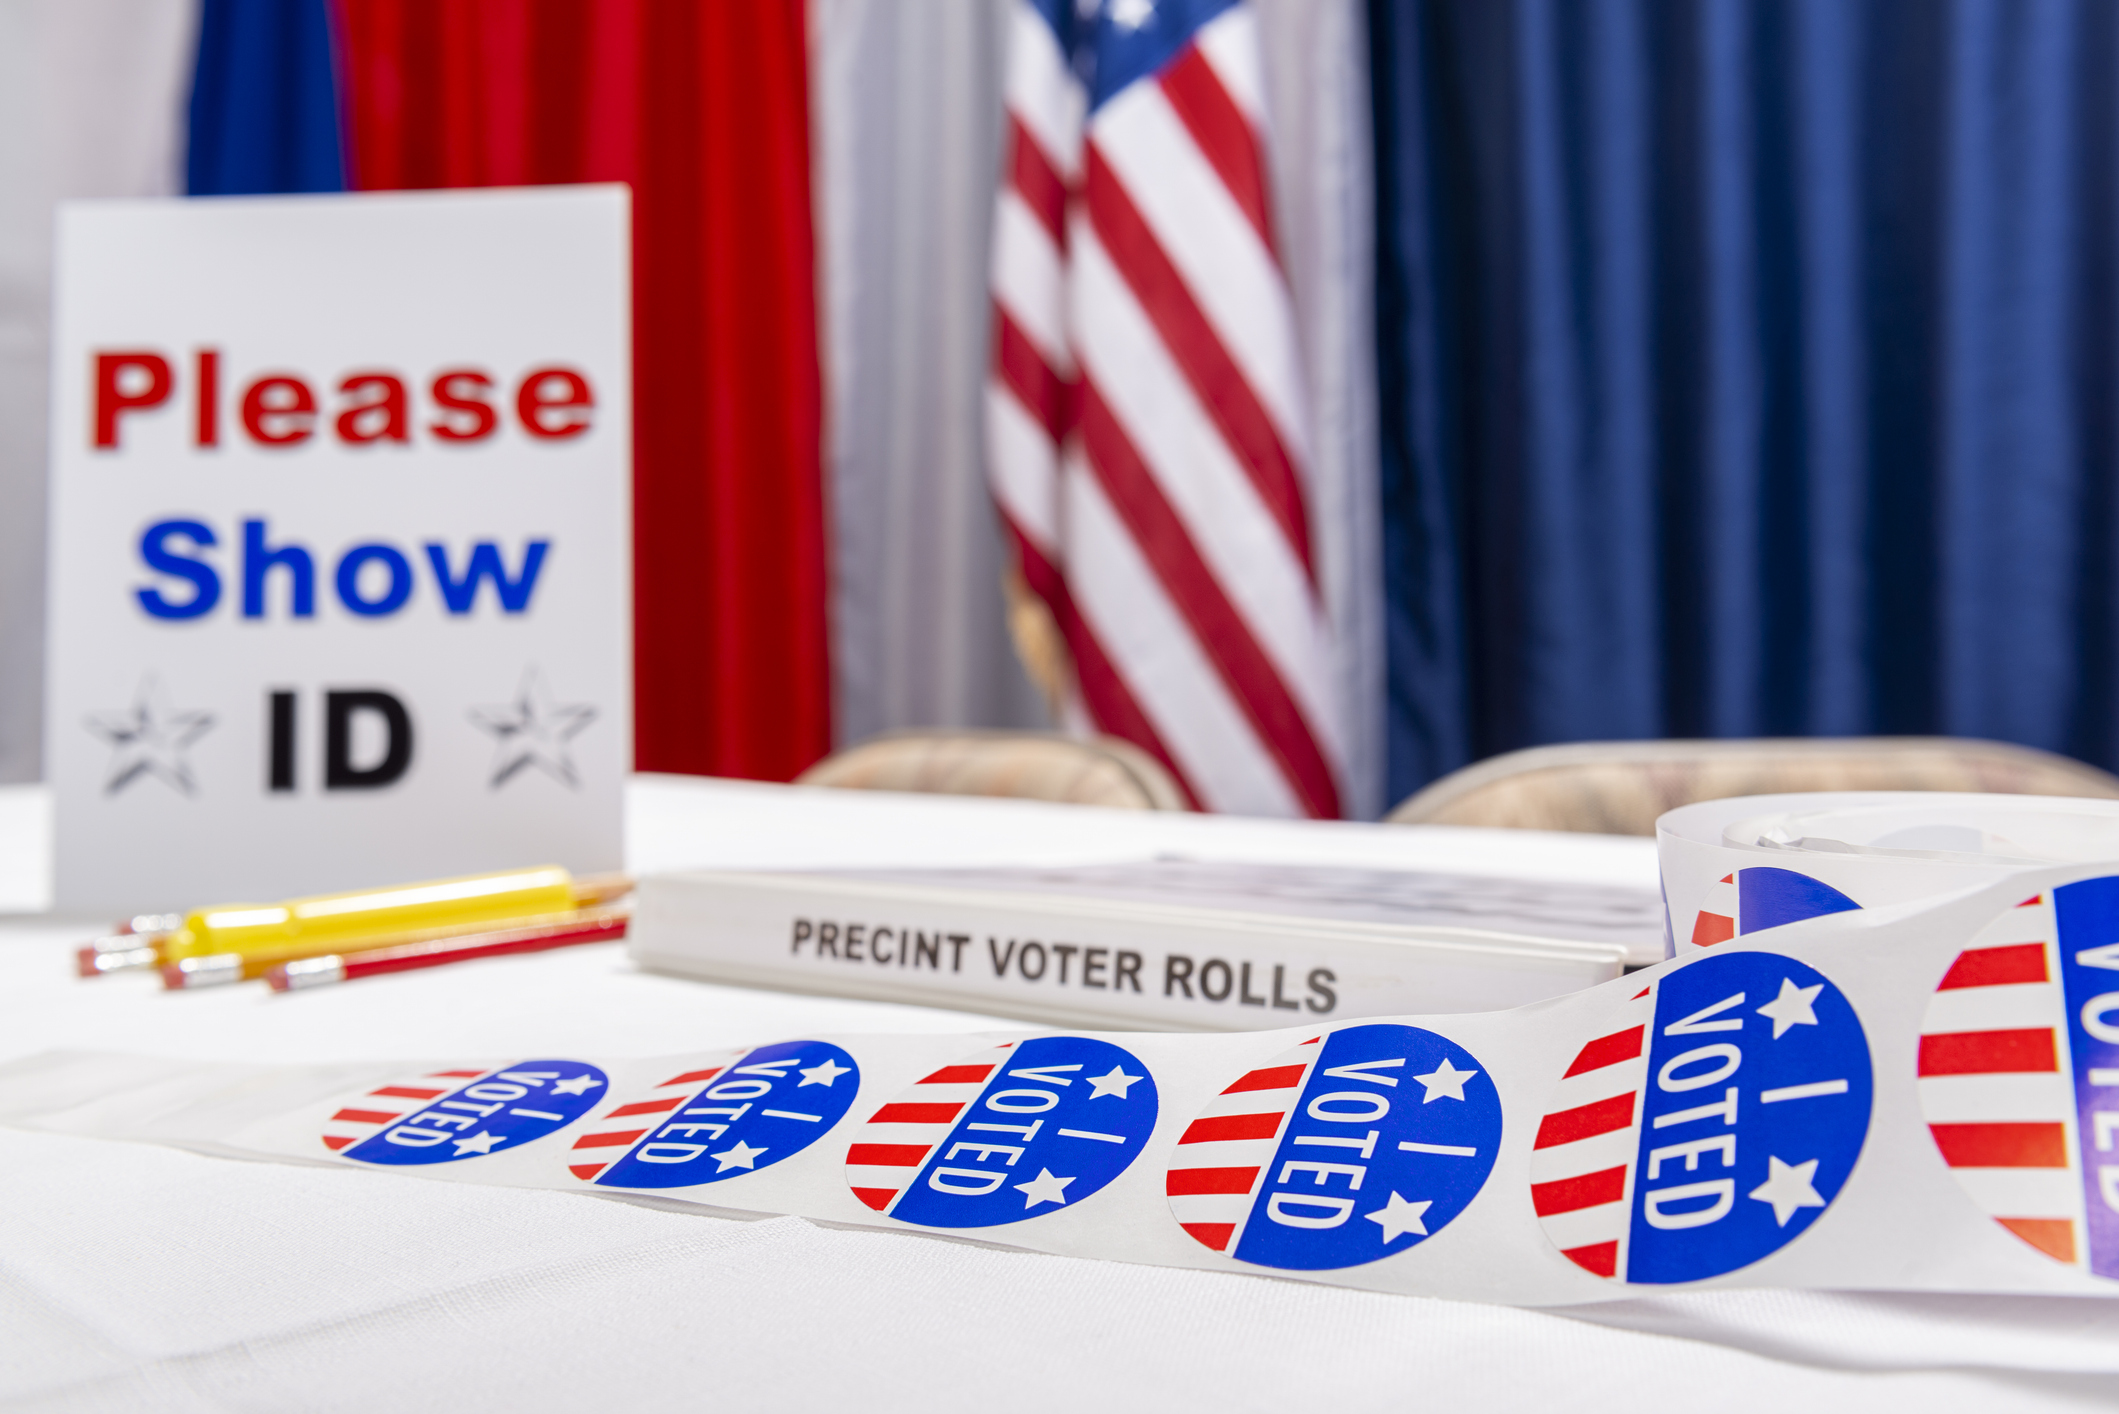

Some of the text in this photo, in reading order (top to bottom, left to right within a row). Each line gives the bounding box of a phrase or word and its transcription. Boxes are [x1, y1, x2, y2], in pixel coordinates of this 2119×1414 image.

[89, 347, 597, 451] Please
[133, 515, 553, 624] Show
[267, 688, 416, 793] ID
[790, 918, 1338, 1015] PRECINT VOTER ROLLS
[384, 1070, 561, 1149] VOTED
[509, 1107, 564, 1122] I
[635, 1058, 801, 1164] VOTED
[761, 1109, 823, 1123] I
[927, 1064, 1084, 1196] VOTED
[1057, 1127, 1127, 1145] I
[1644, 991, 1746, 1231] VOTED
[1760, 1079, 1849, 1104] I
[1266, 1057, 1406, 1230] VOTED
[1397, 1141, 1477, 1157] I
